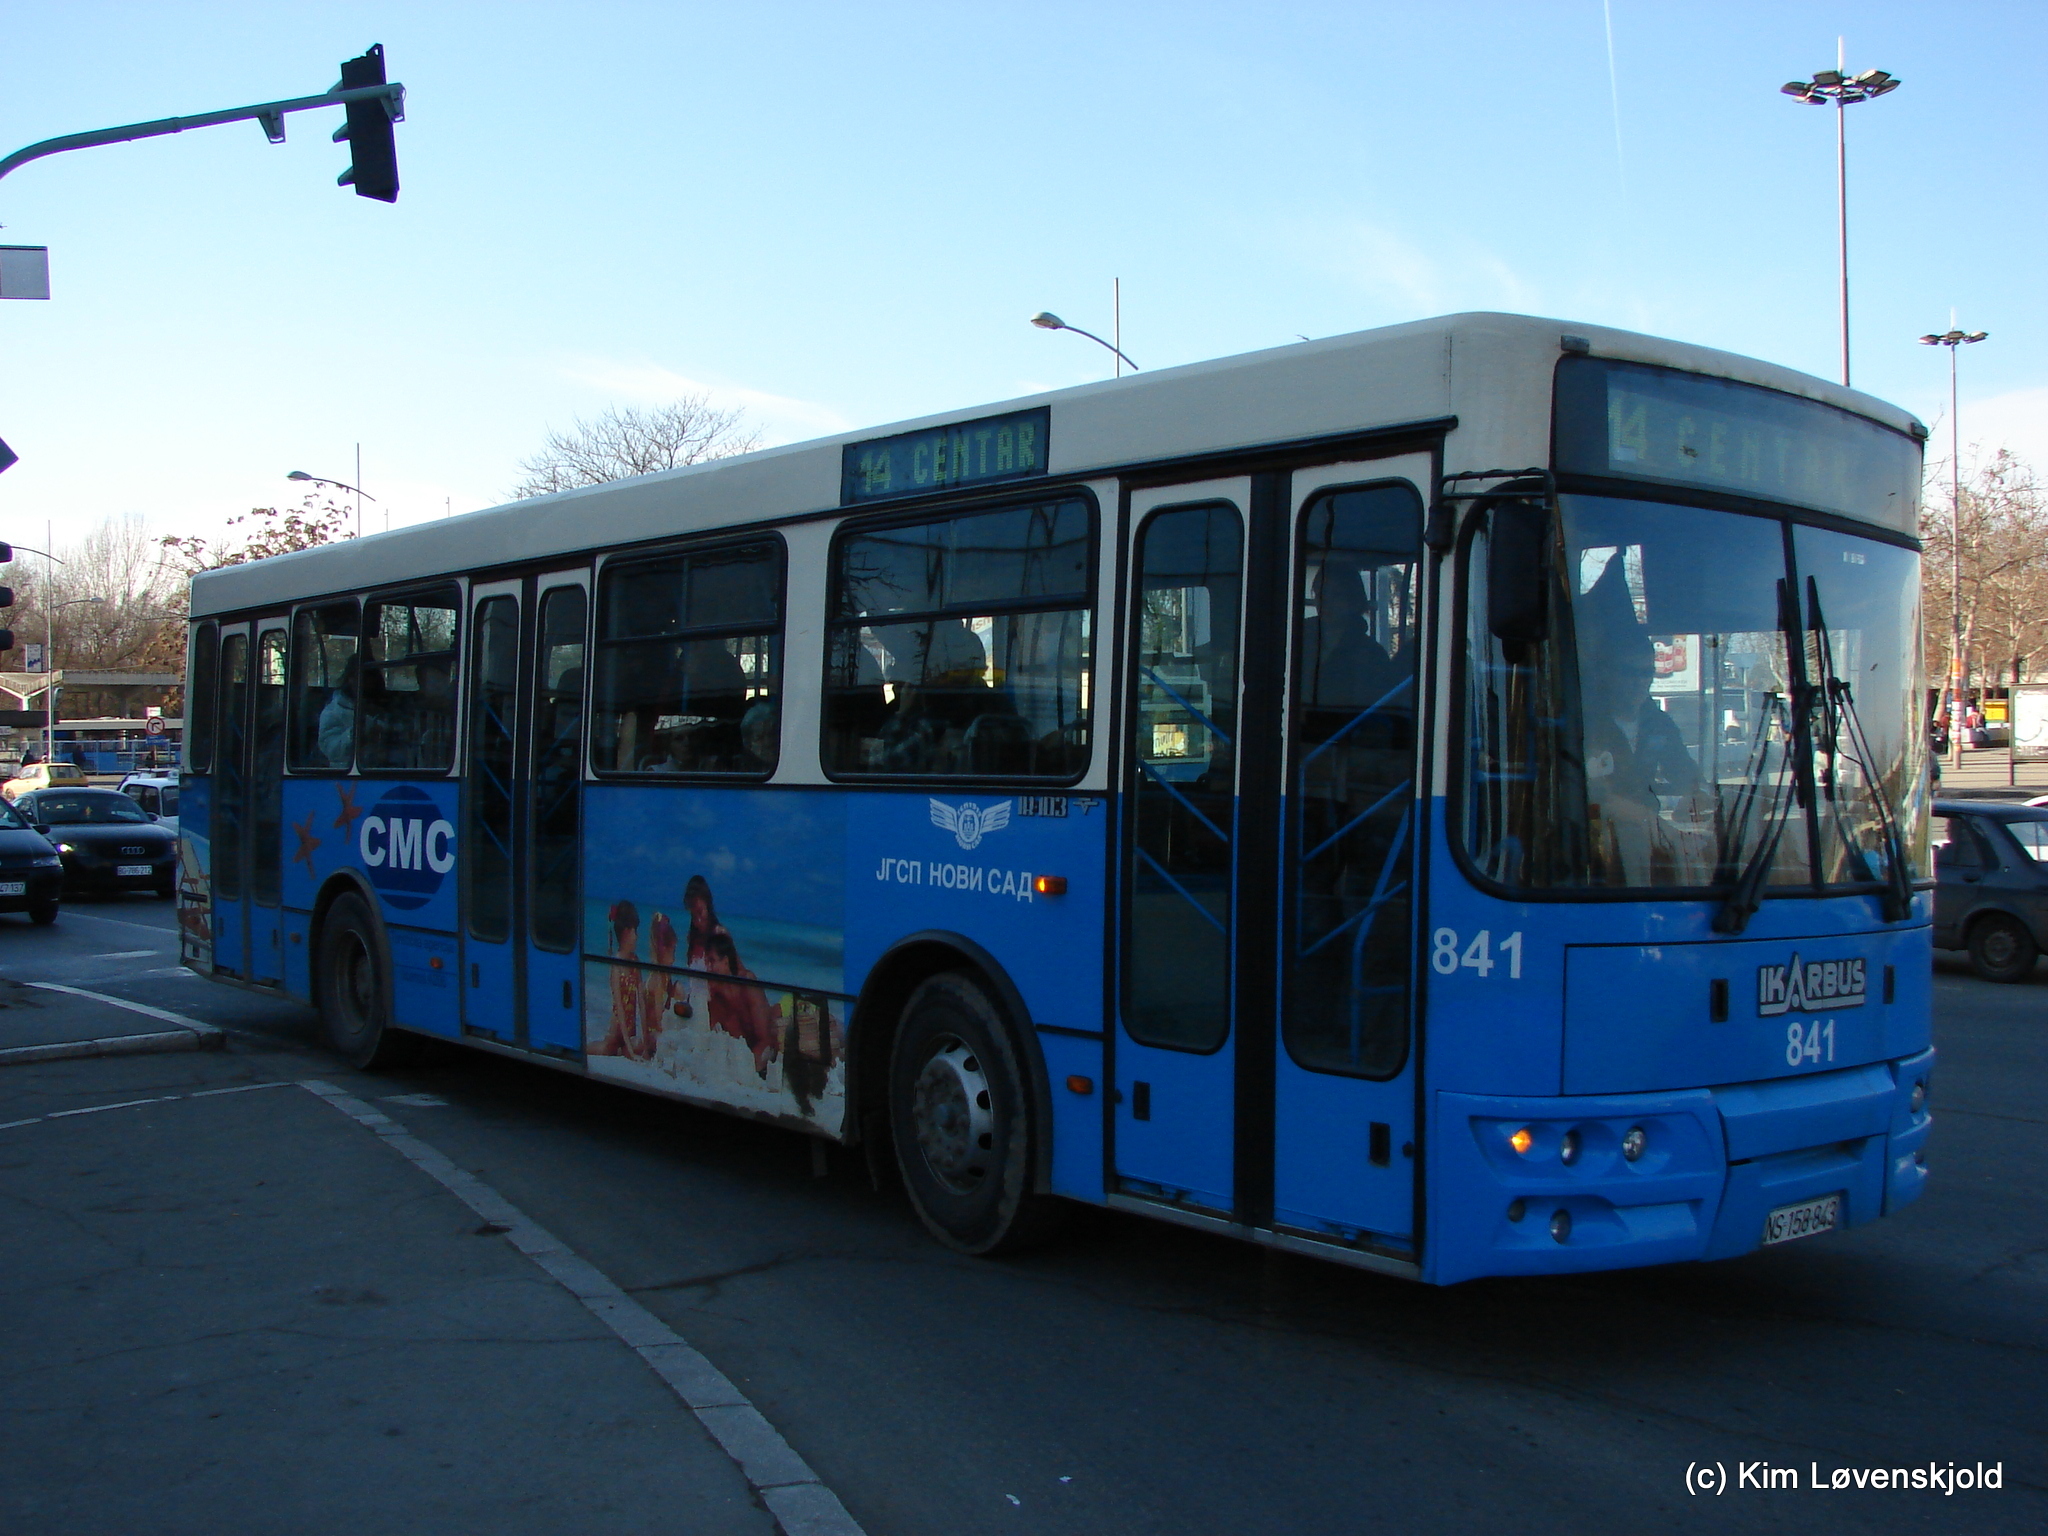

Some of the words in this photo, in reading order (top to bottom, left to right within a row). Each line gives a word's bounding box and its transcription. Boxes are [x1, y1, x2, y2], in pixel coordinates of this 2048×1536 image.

[860, 448, 892, 493] 14
[913, 422, 1036, 484] CENTAR
[360, 815, 455, 873] CMC
[929, 862, 982, 891] НОВИ
[987, 868, 1033, 903] САД
[1432, 927, 1522, 979] 841
[1760, 953, 1865, 1015] IKARBUS
[1786, 1019, 1835, 1067] 841
